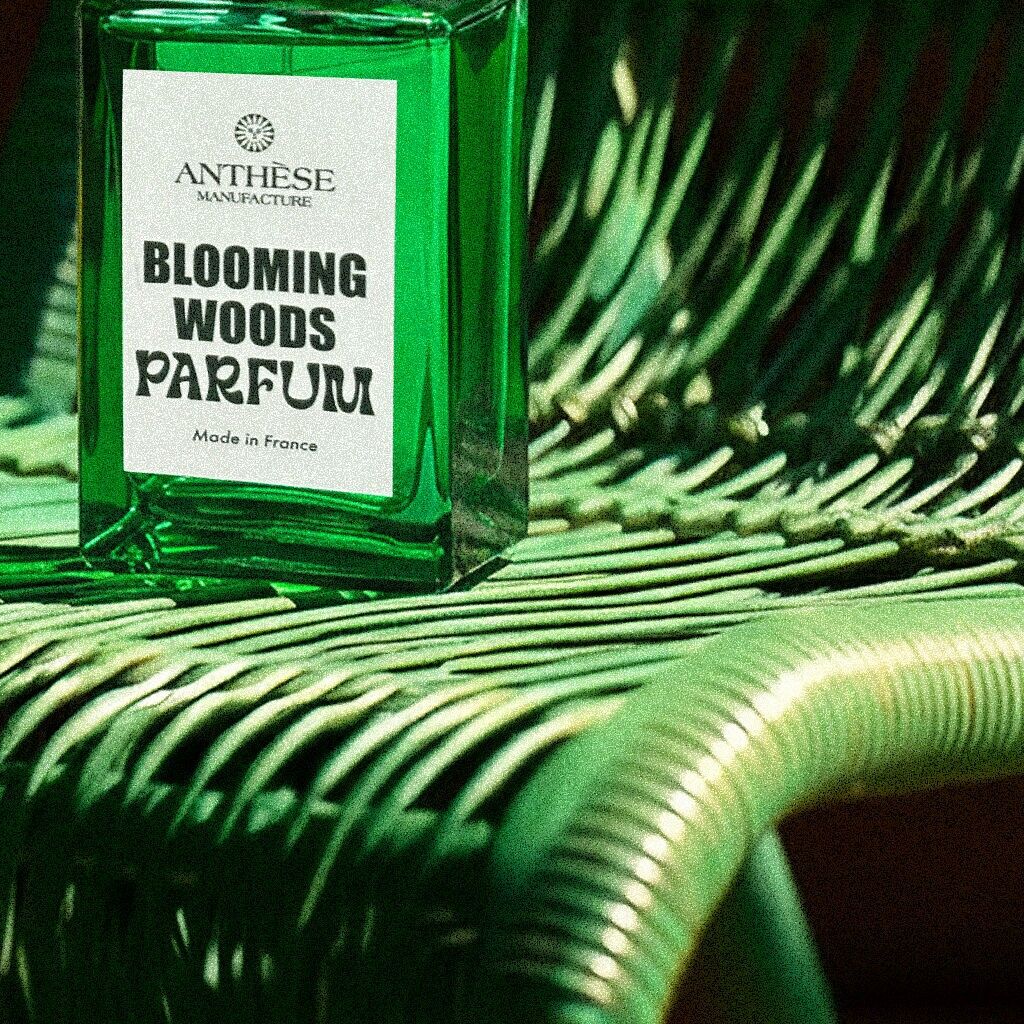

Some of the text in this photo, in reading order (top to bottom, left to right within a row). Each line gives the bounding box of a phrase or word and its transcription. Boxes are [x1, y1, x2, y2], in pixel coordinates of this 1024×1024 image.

[175, 161, 336, 192] ANTHÈSE
[197, 190, 312, 208] MANUFACTURE
[143, 240, 367, 298] BLOOMING
[173, 297, 336, 352] WOODS
[135, 350, 375, 416] PARFUM
[192, 429, 318, 452] Made in France
